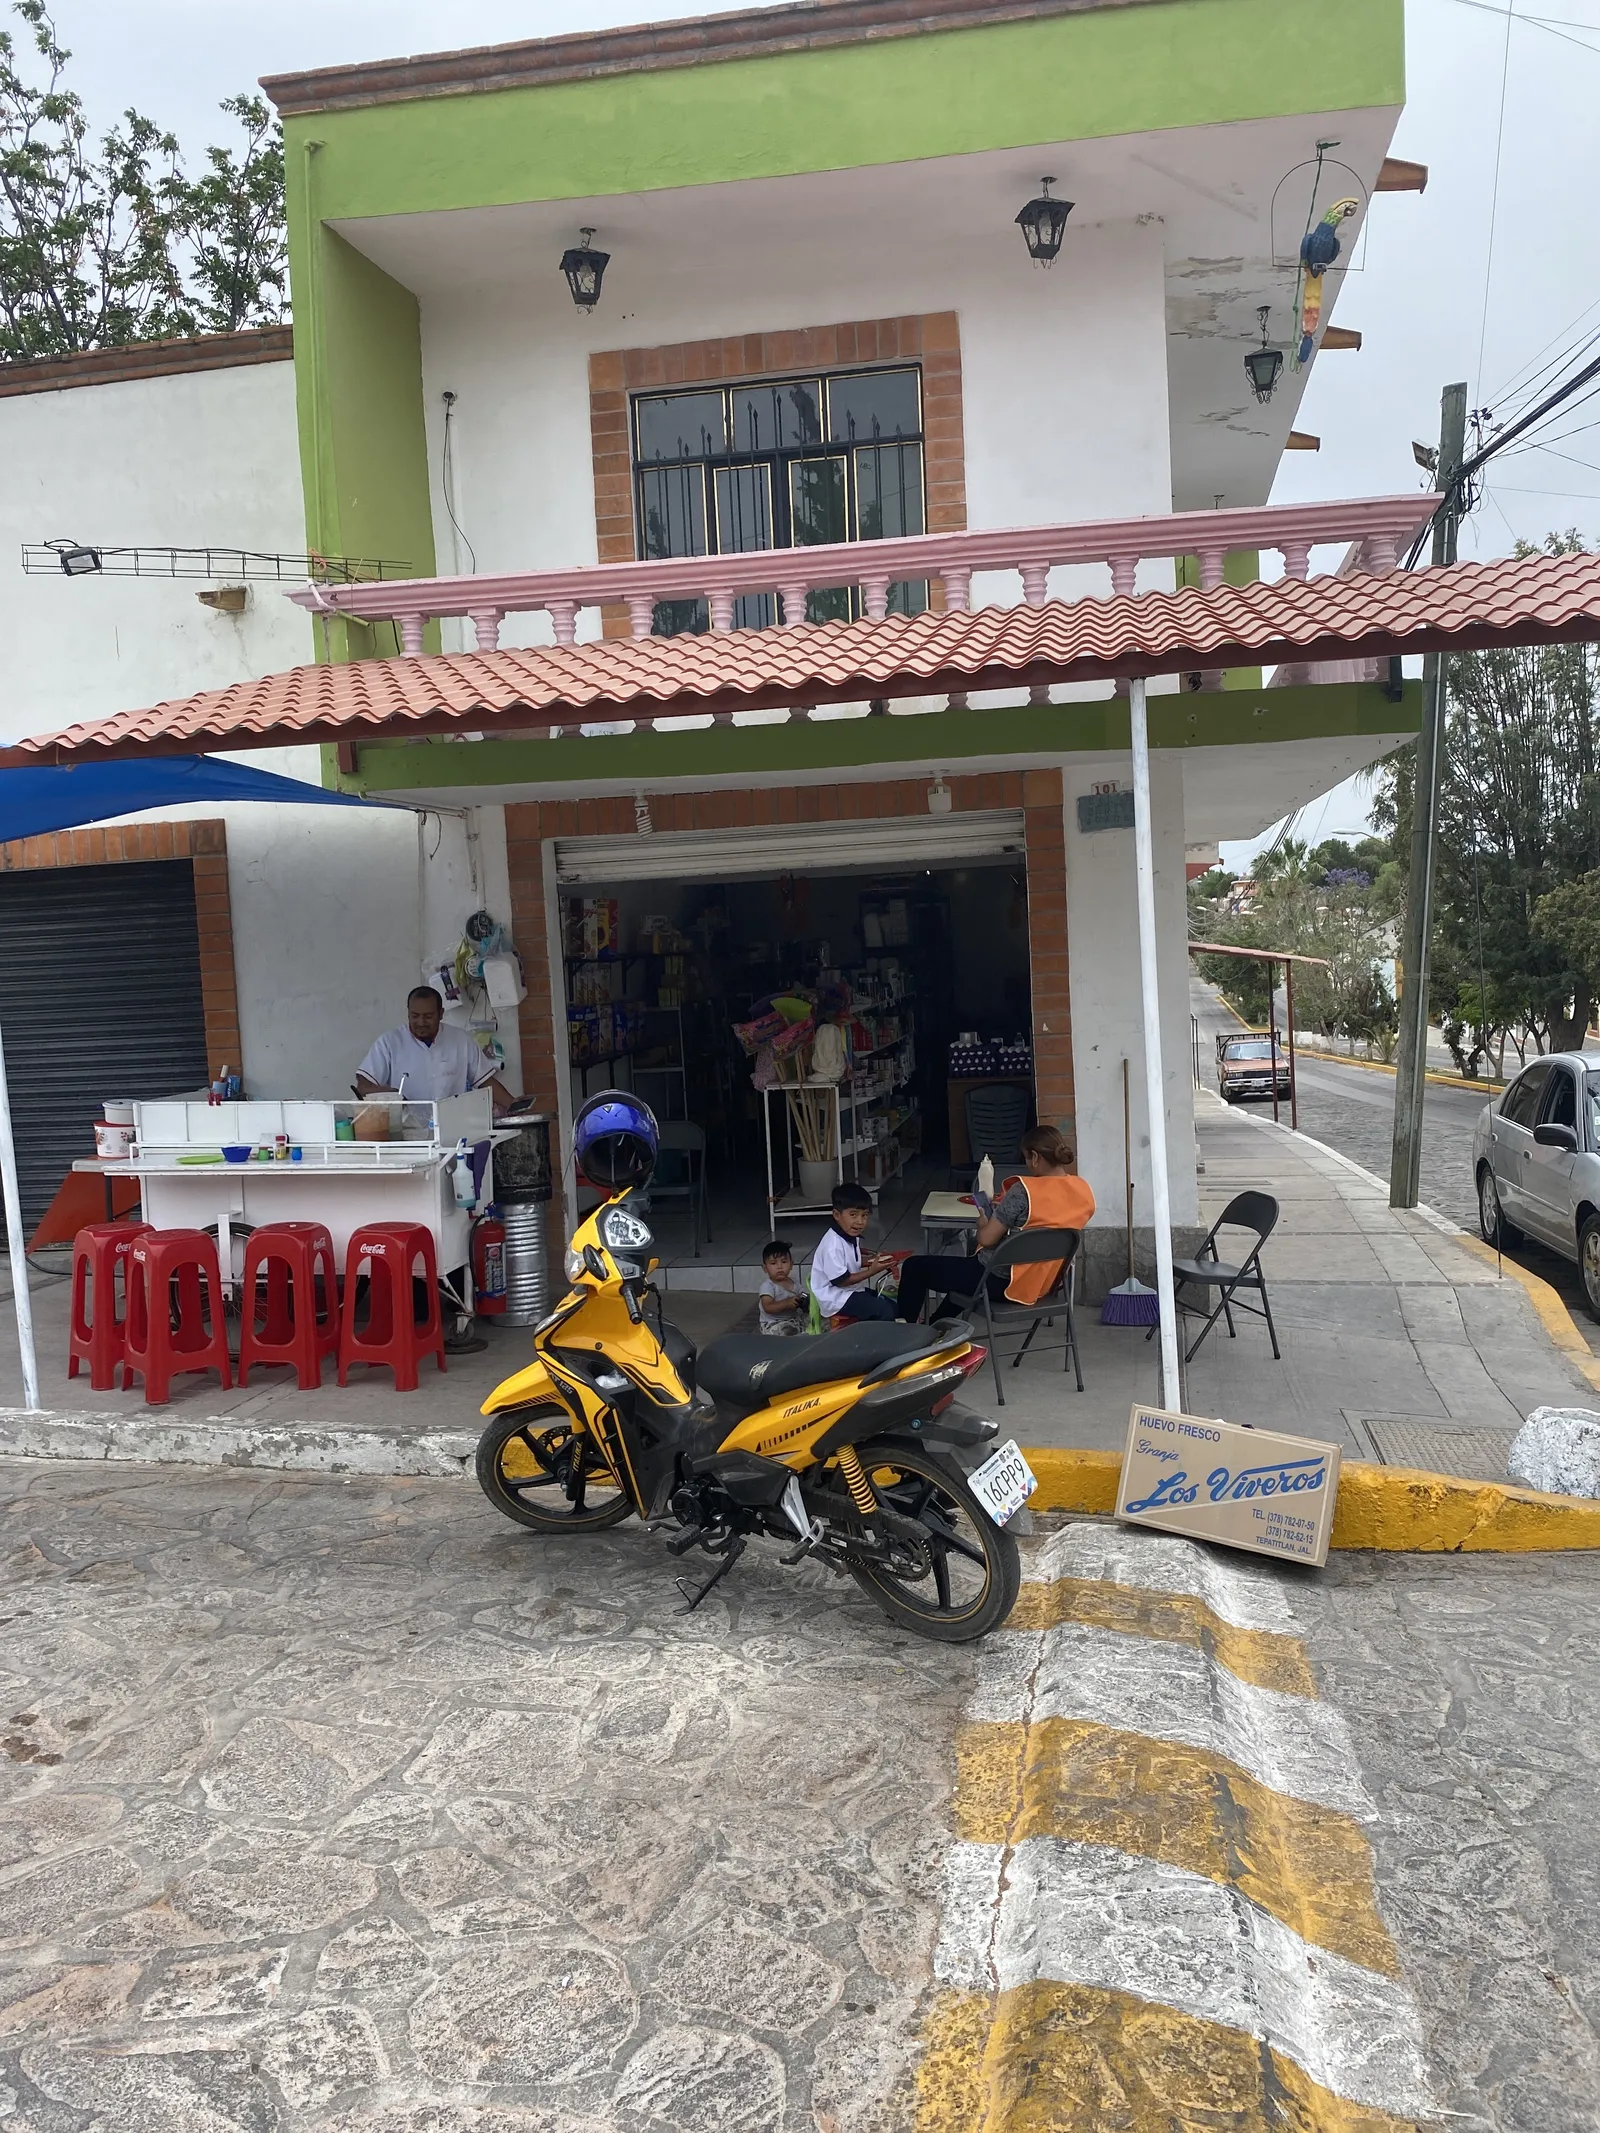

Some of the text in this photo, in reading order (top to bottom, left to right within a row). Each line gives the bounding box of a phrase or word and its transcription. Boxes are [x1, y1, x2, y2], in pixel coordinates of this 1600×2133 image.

[1095, 783, 1117, 795] 101
[1139, 1415, 1221, 1443] HUEVO FRESCO
[1136, 1439, 1180, 1462] Granja
[983, 1458, 1025, 1507] 16CPP9
[1125, 1456, 1326, 1514] Los Viveros
[1265, 1525, 1282, 1540] (378)
[1267, 1511, 1284, 1526] (378)
[1284, 1515, 1315, 1531] 782-07-50
